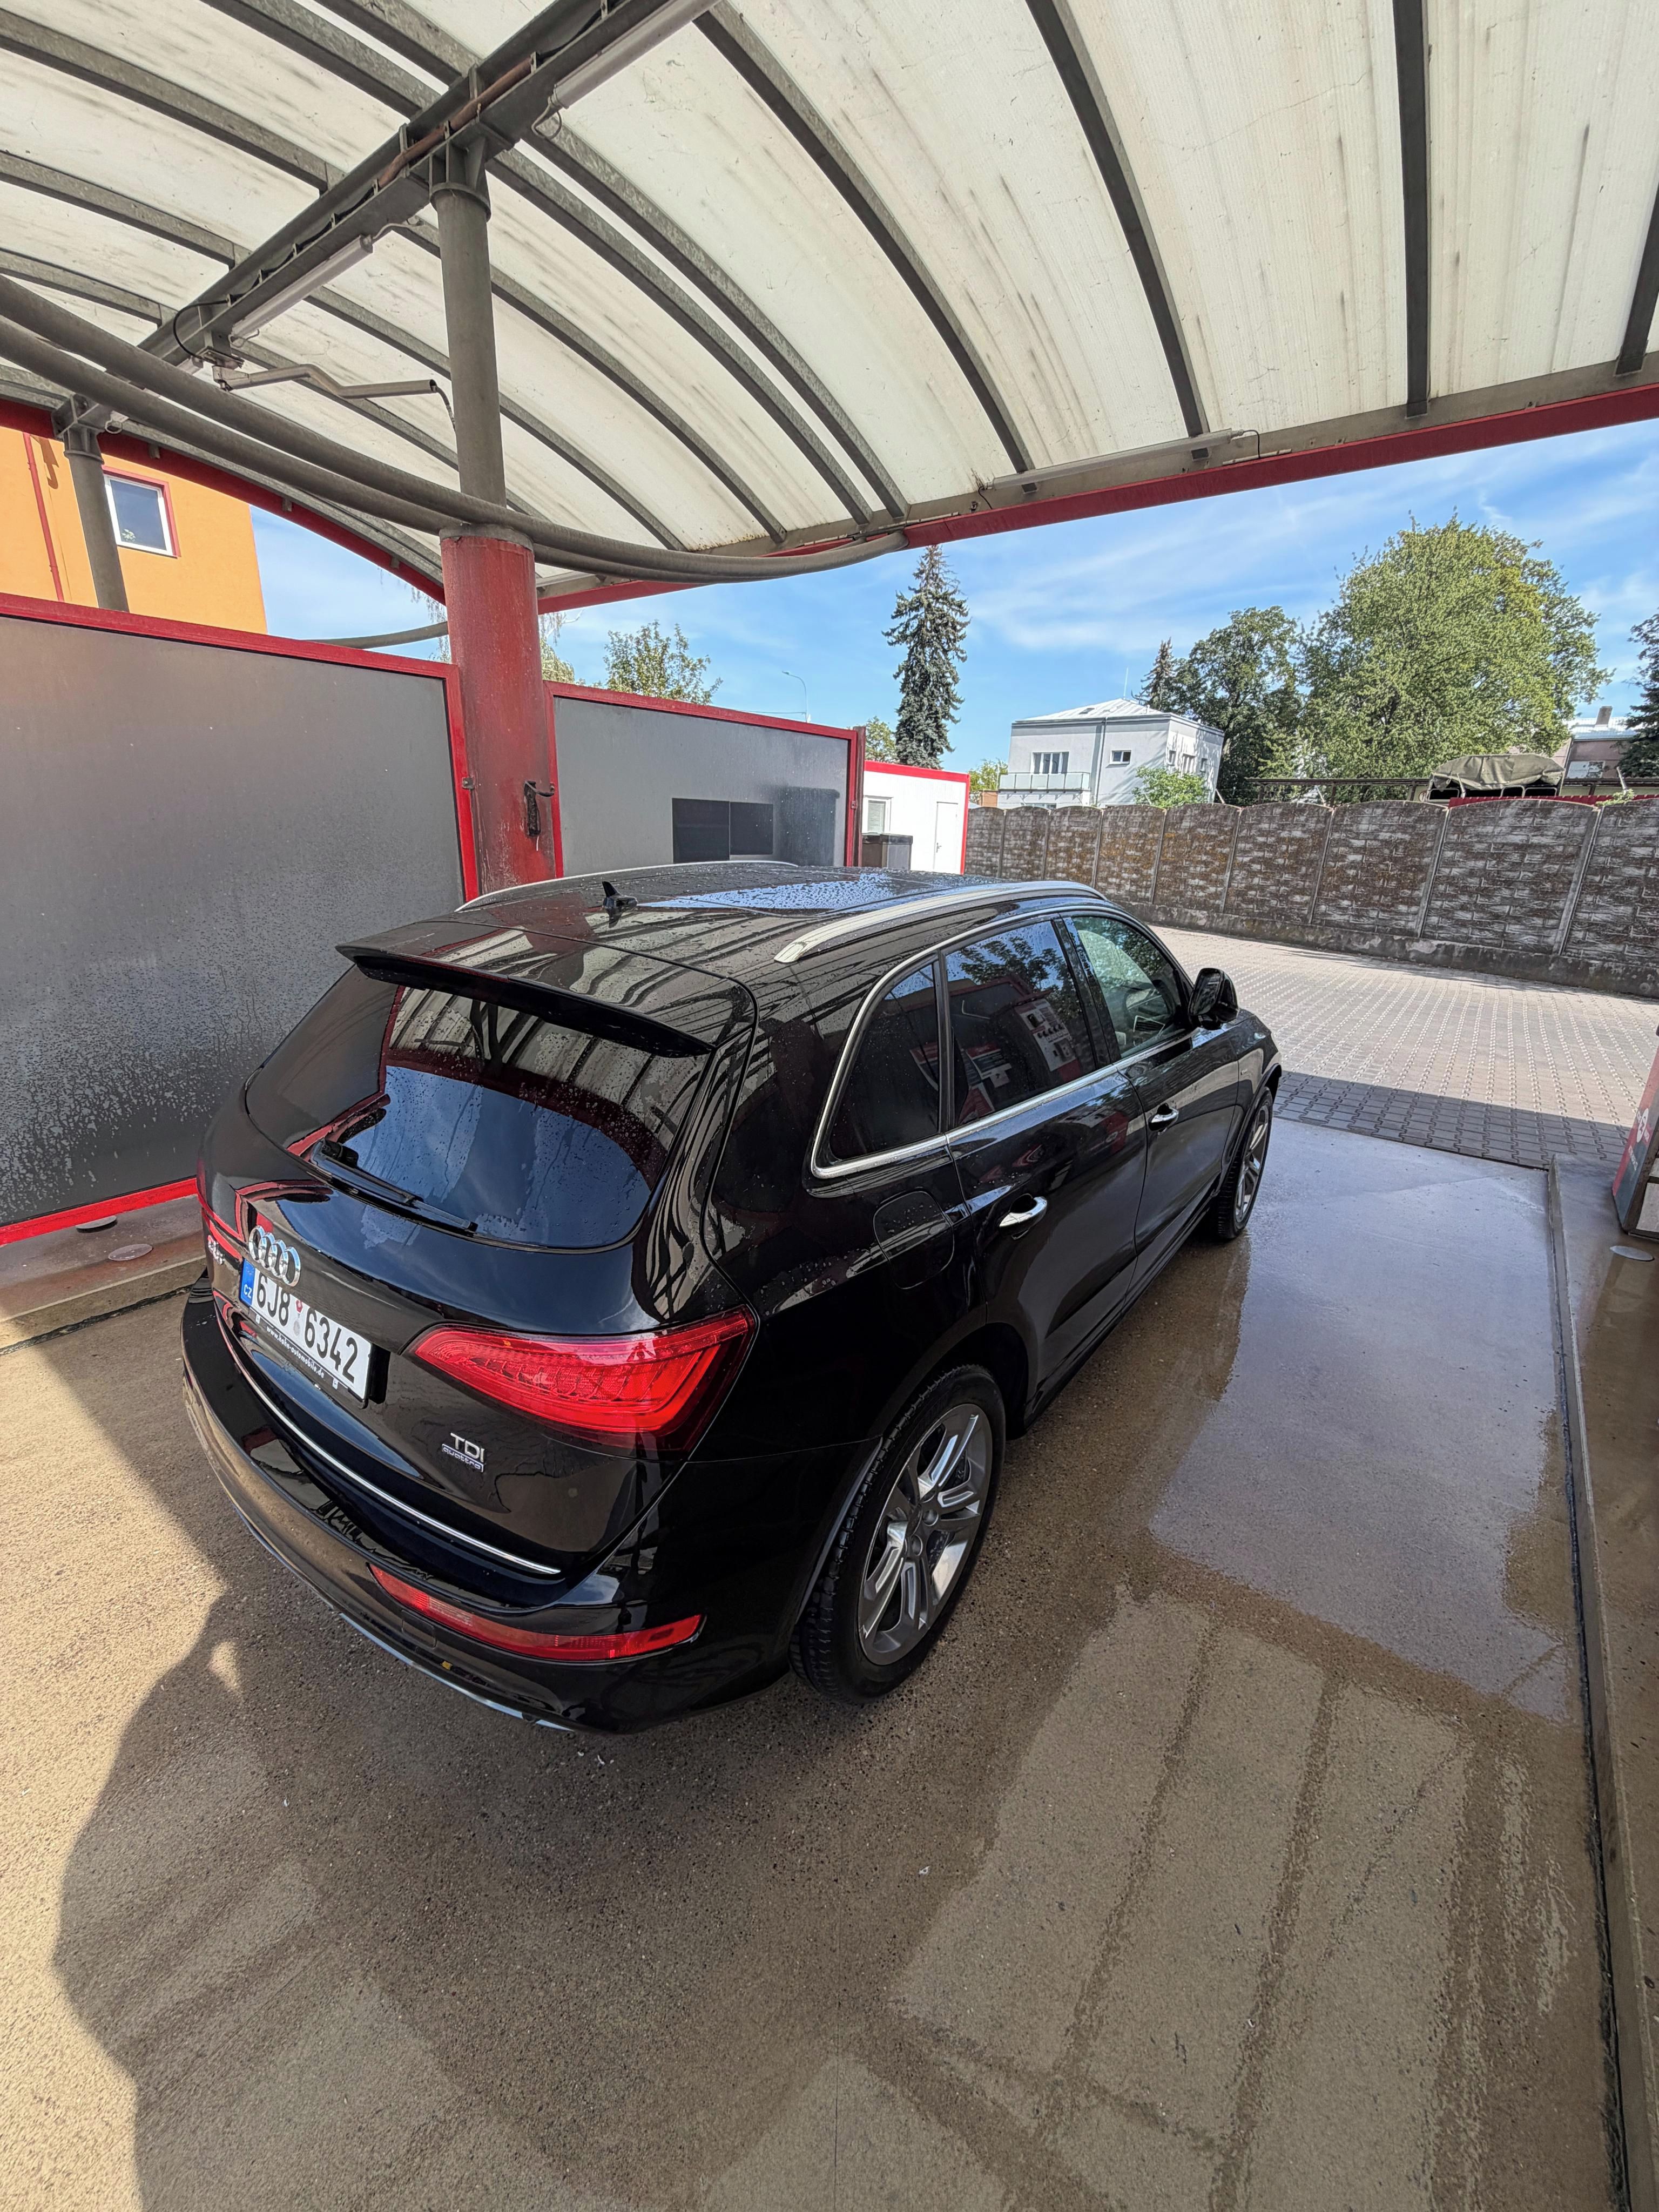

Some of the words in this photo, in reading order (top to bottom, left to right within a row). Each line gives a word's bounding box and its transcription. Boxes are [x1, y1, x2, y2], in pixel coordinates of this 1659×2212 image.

[244, 1284, 252, 1299] CZ
[257, 1271, 290, 1326] 6J8
[305, 1306, 358, 1384] 6342
[267, 1326, 324, 1378] www.hahn-automobile.de
[443, 1447, 481, 1469] quattro
[450, 1432, 485, 1463] TDI
